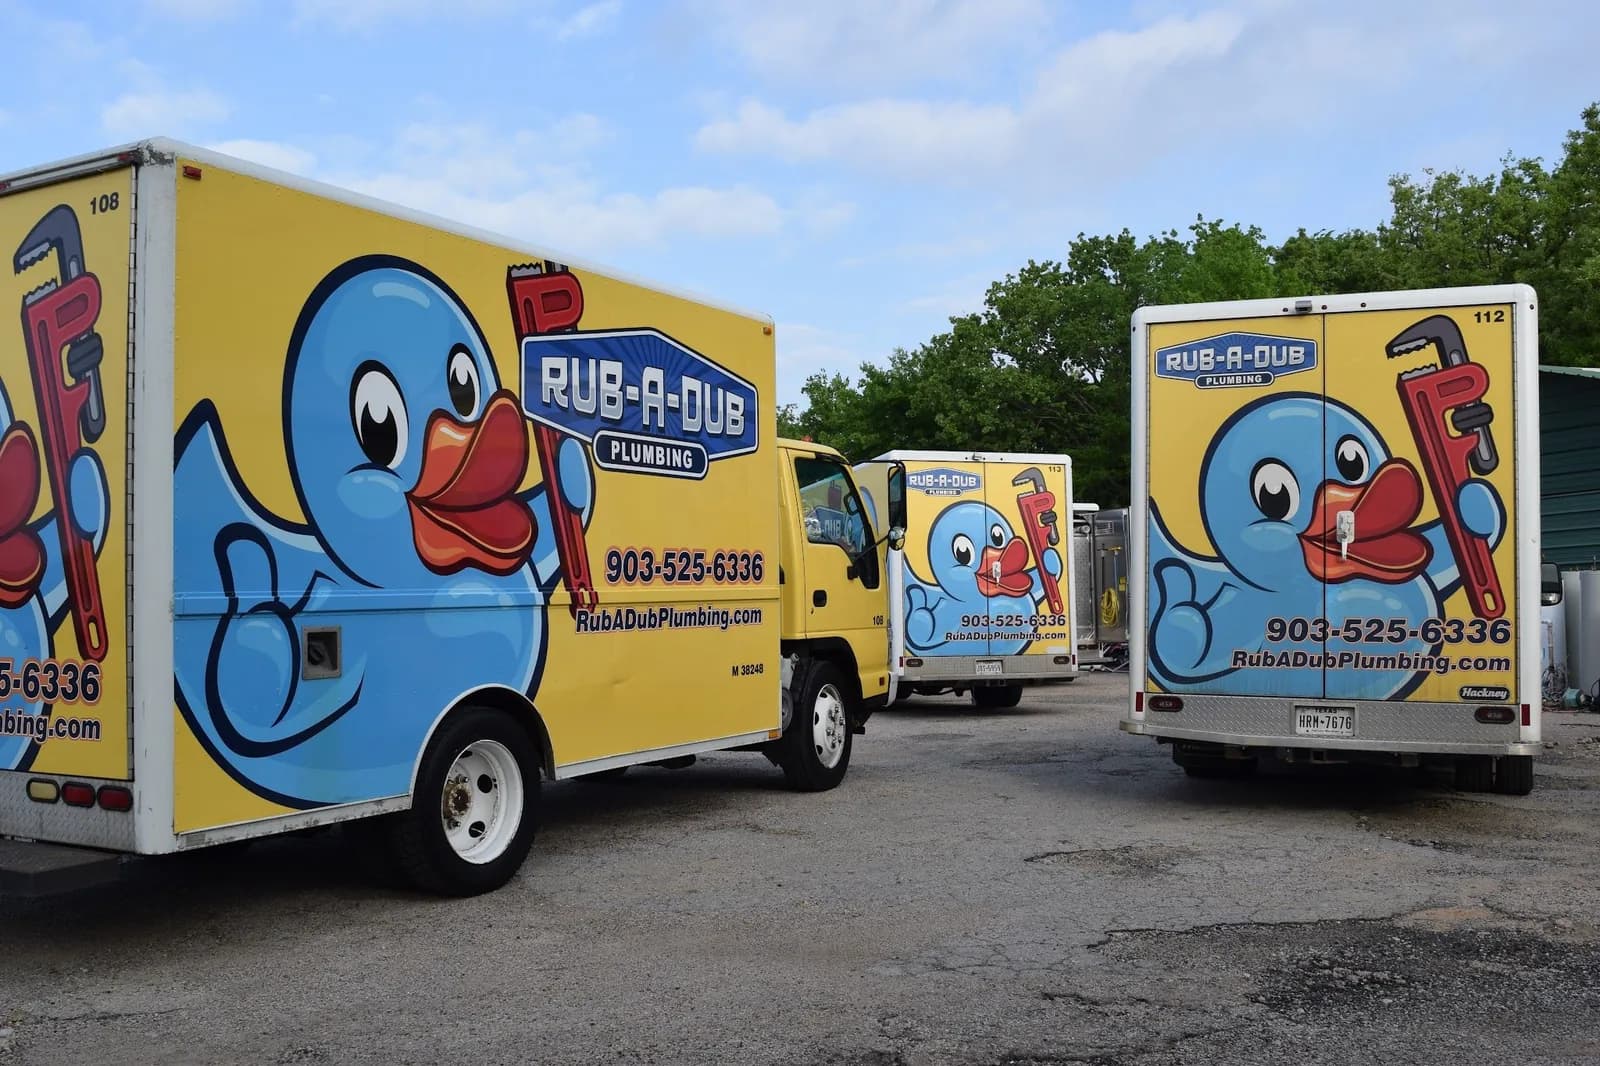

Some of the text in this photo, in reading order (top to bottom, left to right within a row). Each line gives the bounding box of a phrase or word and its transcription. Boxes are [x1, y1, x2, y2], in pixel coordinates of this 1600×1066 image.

[90, 192, 119, 214] 108
[1474, 310, 1505, 323] 112
[1166, 345, 1306, 371] RUB-A-DUB
[1206, 375, 1263, 385] PLUMBING
[541, 356, 745, 436] RUB-A-DUB
[611, 440, 693, 469] PLUMBING
[909, 474, 977, 487] RUB-A-DUB
[605, 549, 764, 584] 903-525-6336
[576, 606, 762, 633] RubADubPlumbing.com
[961, 614, 1066, 627] 903-525-6336
[1266, 617, 1512, 645] 903-525-6336
[945, 631, 1066, 641] RubADubPlumbing.com
[732, 665, 739, 677] M
[1231, 650, 1511, 674] RubADubPlumbing.com
[1461, 687, 1508, 699] Hackney
[0, 709, 101, 742] bing.com
